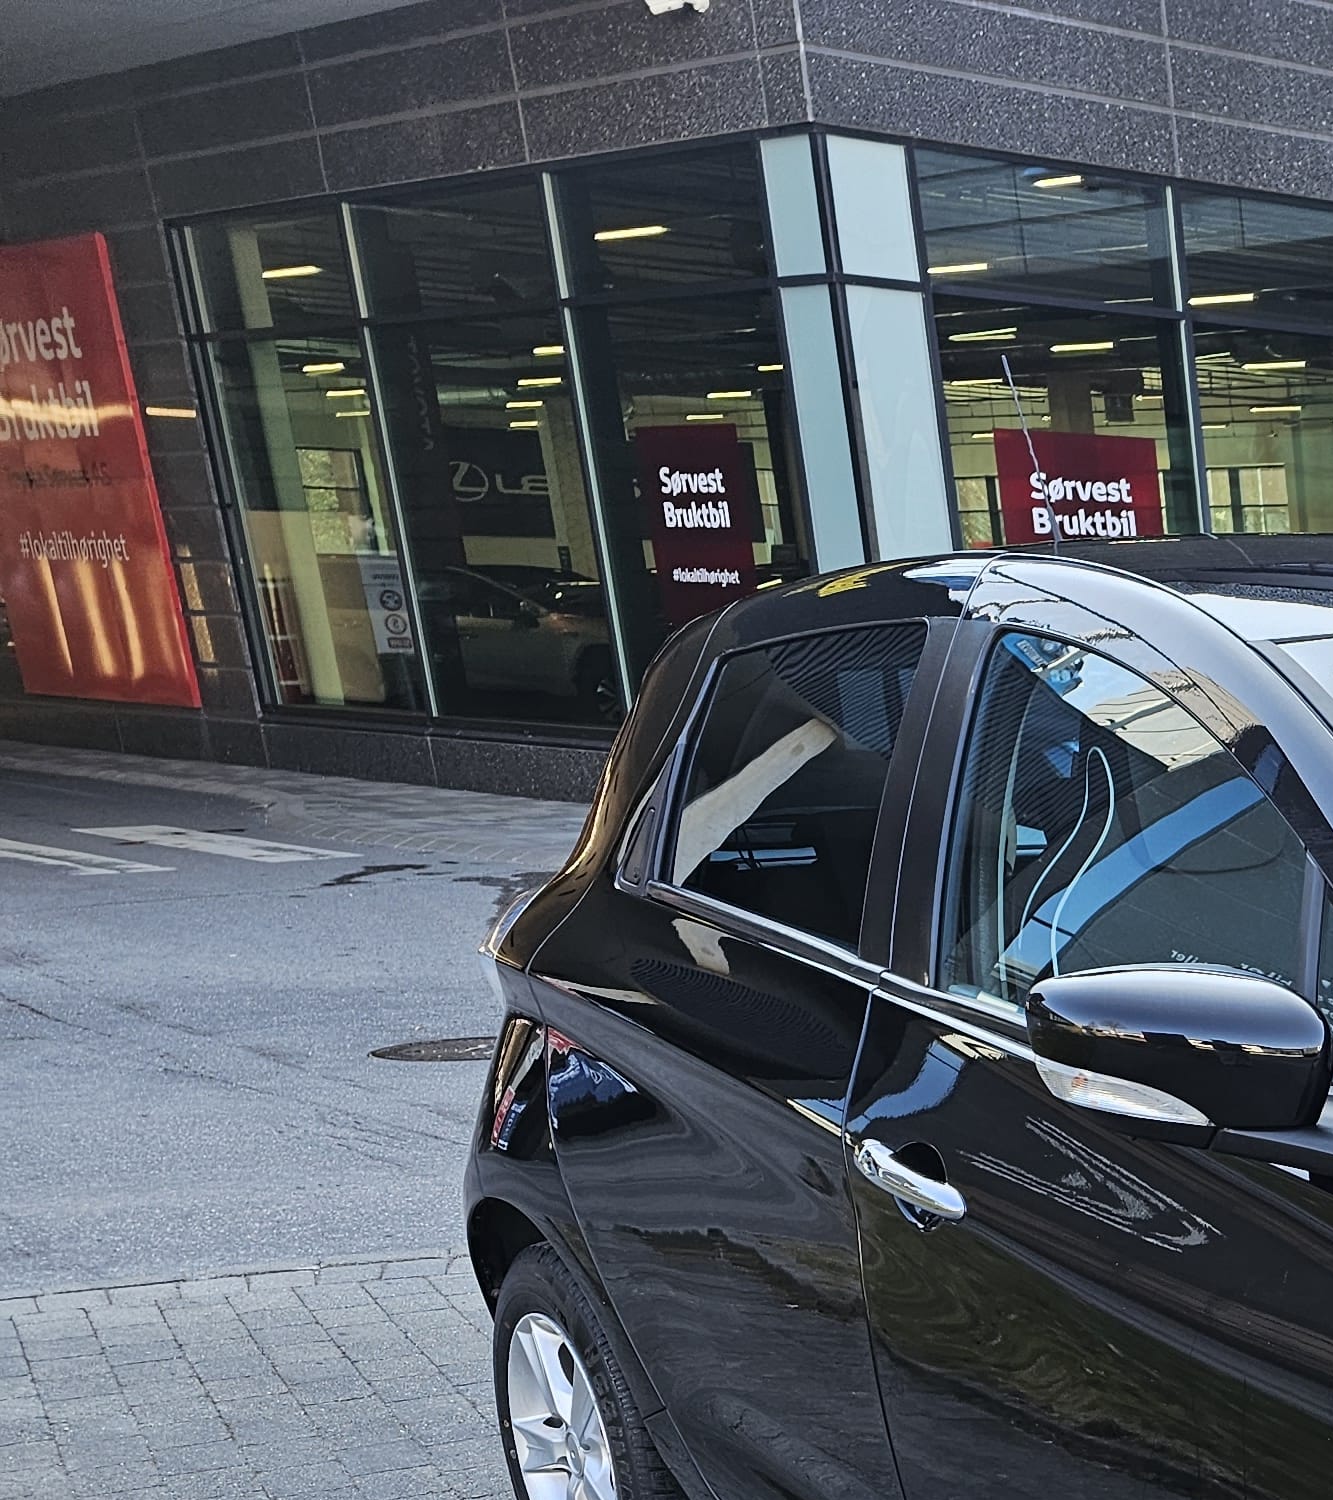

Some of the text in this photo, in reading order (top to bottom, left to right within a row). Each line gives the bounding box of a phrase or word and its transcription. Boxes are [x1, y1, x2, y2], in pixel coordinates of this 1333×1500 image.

[0, 380, 99, 441] ruktbil
[659, 466, 726, 497] Sørvest
[1029, 471, 1133, 503] Sørvest
[663, 500, 732, 529] Bruktbil
[1031, 506, 1137, 538] Bruktbil
[19, 531, 130, 568] #lokaltilhørighet
[672, 567, 741, 588] #lokaltilhørighet
